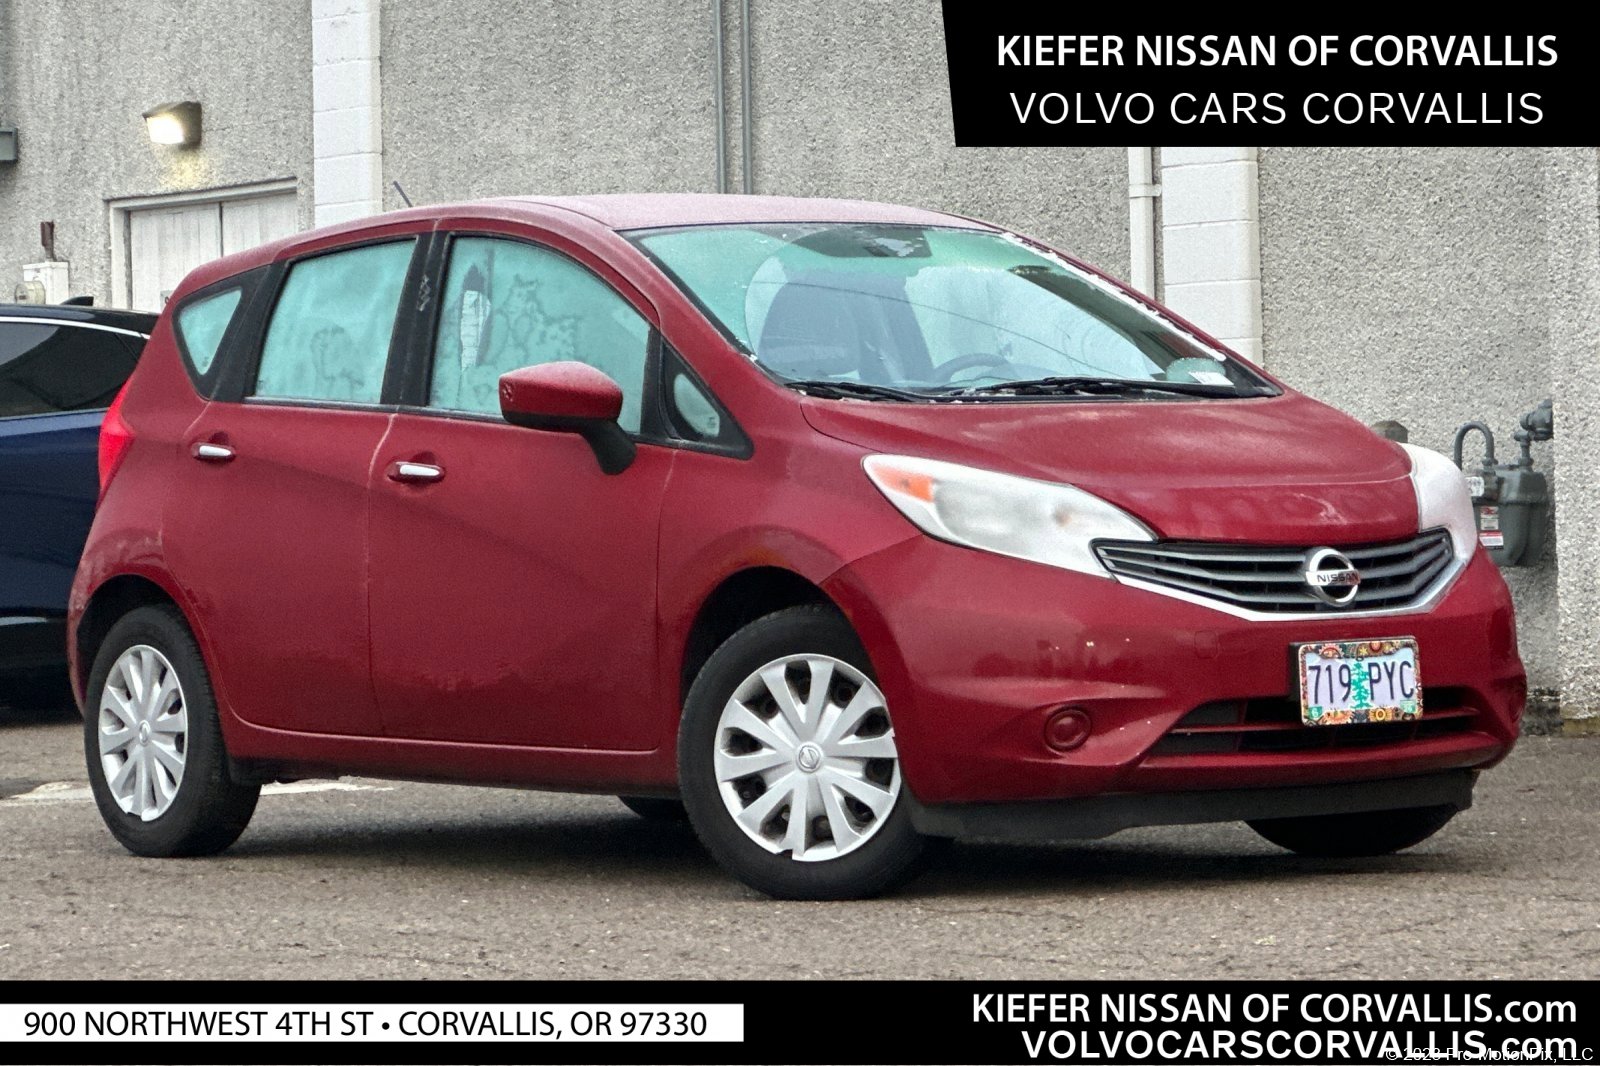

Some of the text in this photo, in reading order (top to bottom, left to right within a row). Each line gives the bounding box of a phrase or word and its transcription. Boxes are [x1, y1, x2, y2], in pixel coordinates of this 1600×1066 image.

[1316, 572, 1359, 583] NISSAN
[1308, 661, 1414, 704] 719 PYC
